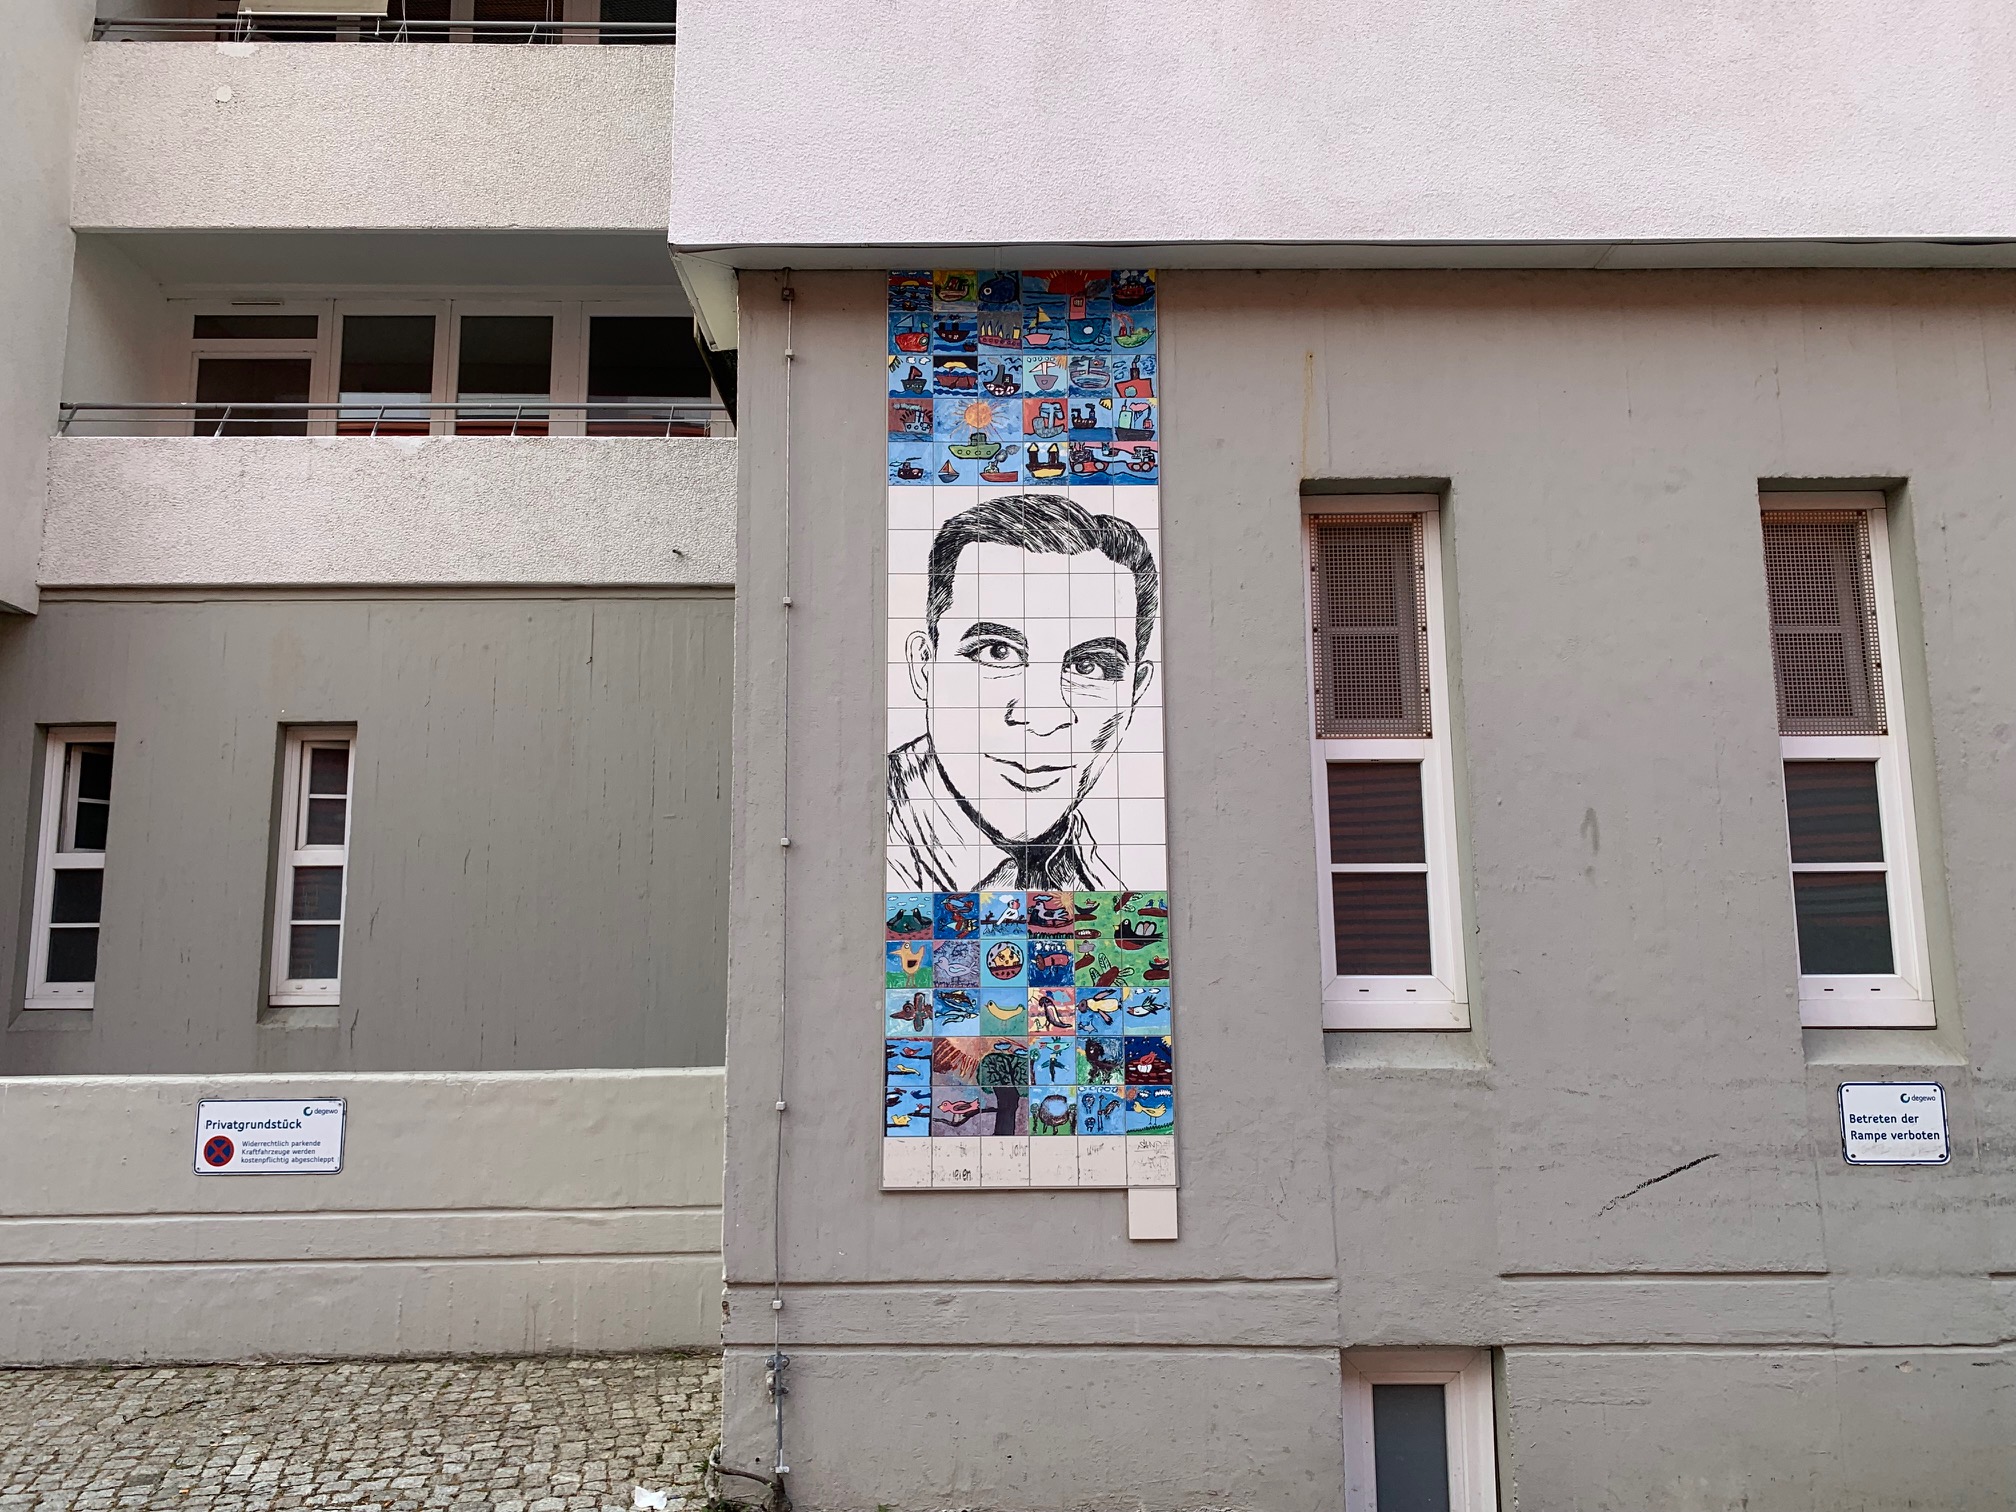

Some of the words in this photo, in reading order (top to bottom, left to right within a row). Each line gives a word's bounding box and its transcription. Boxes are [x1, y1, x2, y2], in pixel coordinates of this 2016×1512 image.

[1911, 1094, 1936, 1103] degewo
[313, 1107, 339, 1116] degewo
[1849, 1113, 1897, 1124] Betreten
[1901, 1113, 1919, 1124] der
[205, 1118, 302, 1132] Privatgrundstück
[1850, 1130, 1888, 1143] Rampe
[1890, 1129, 1940, 1141] verboten
[291, 1140, 321, 1149] parkende
[291, 1156, 335, 1164] abgeschleppt
